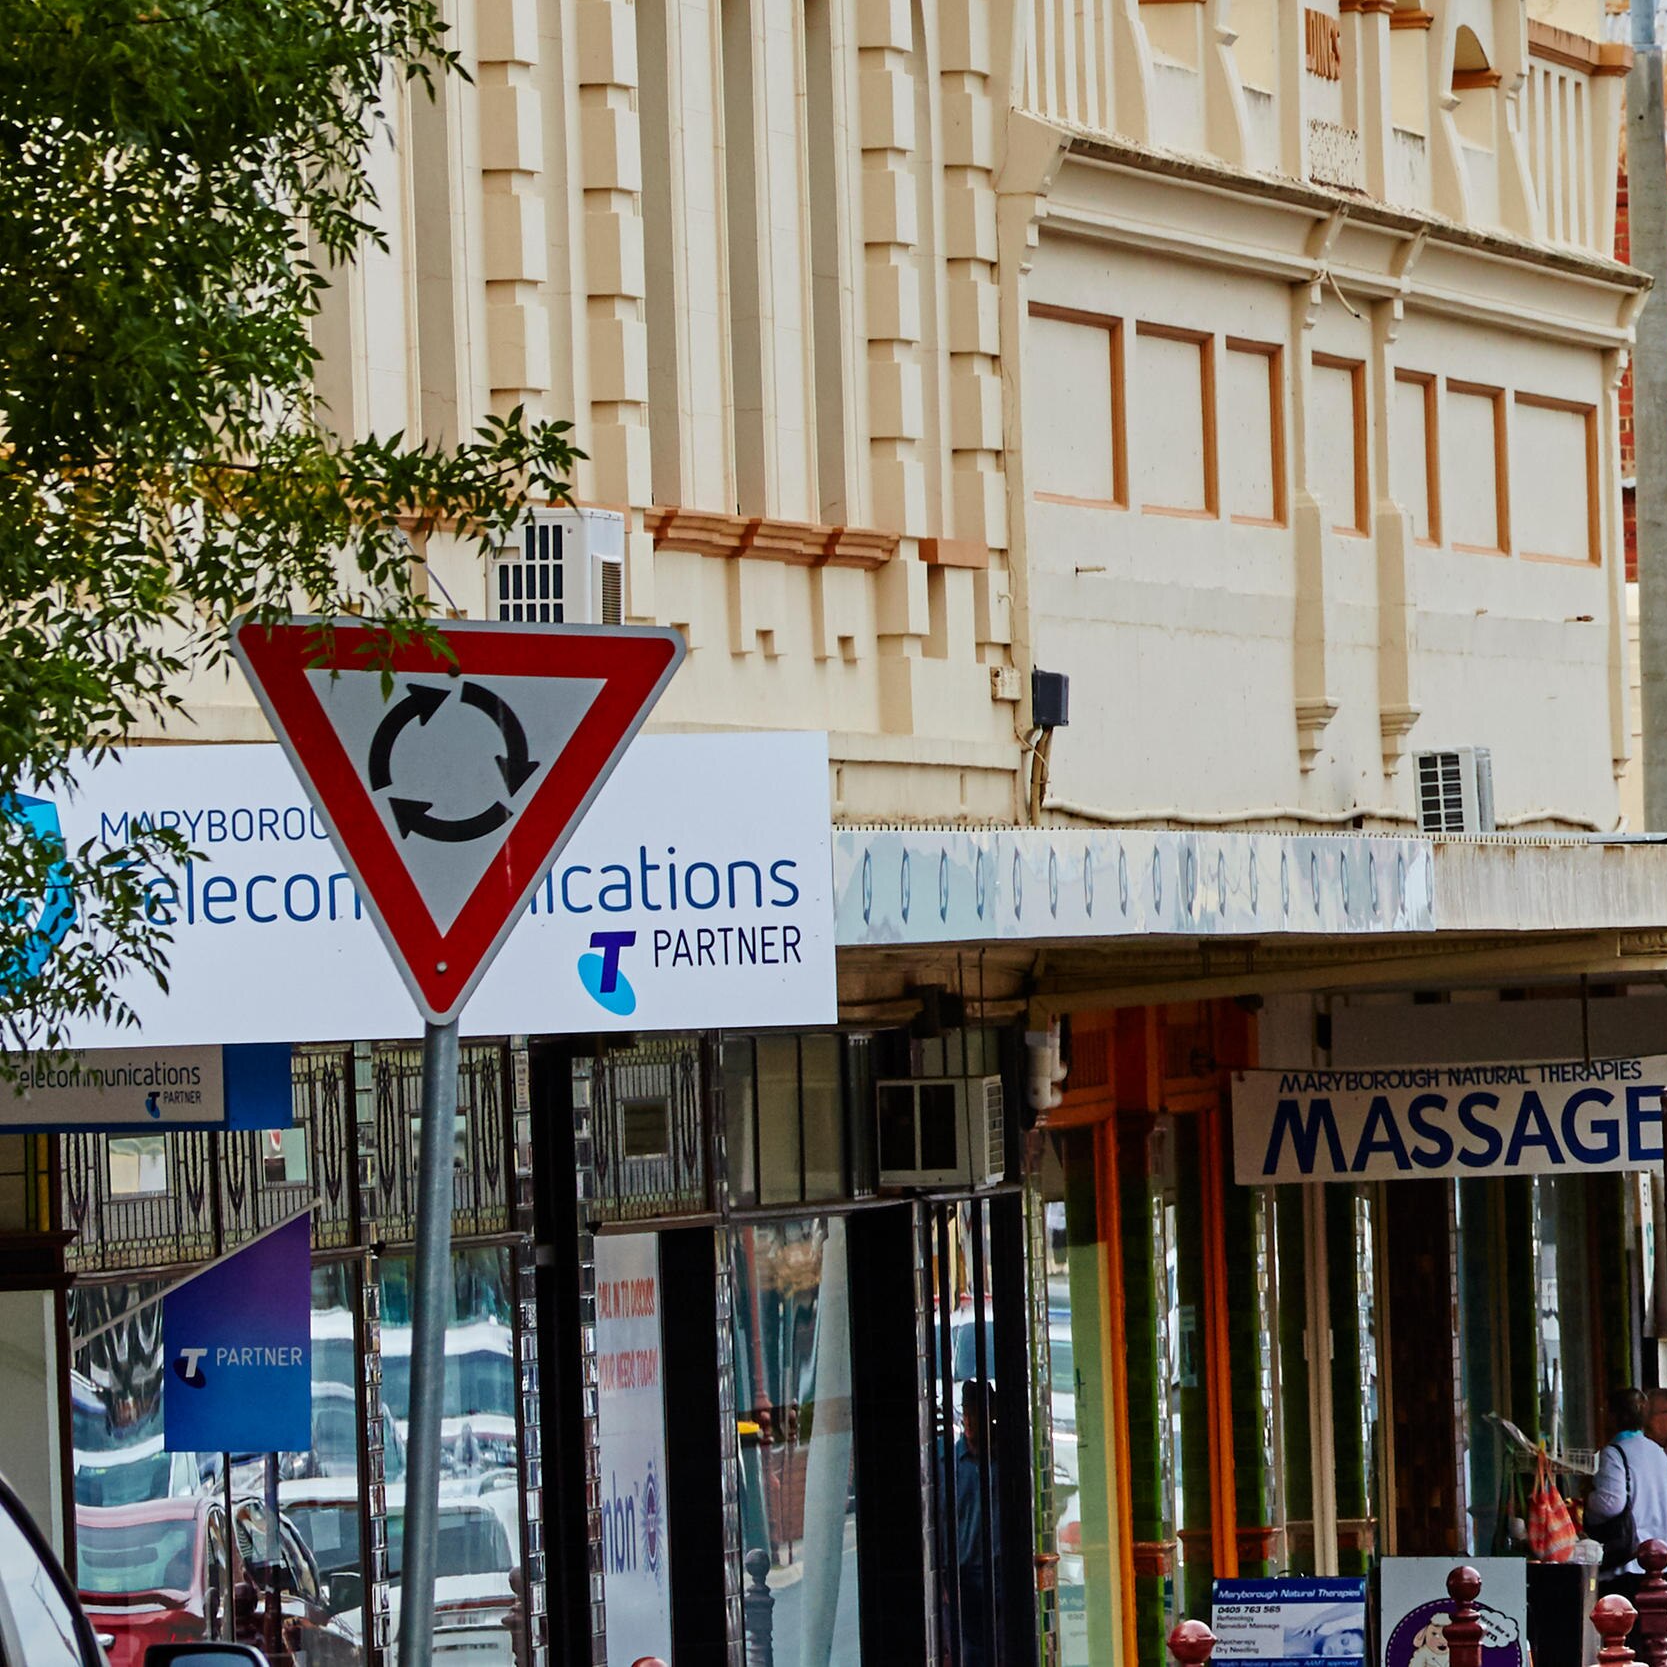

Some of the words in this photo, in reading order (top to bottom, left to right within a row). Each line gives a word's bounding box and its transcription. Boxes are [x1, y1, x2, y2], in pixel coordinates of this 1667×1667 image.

[101, 806, 331, 844] MARYBOROU
[654, 925, 801, 968] PARTNER
[1279, 1067, 1440, 1094] MARYBOROUGH
[1448, 1064, 1531, 1087] NATURAL
[1537, 1059, 1643, 1085] THERAPIES
[163, 1090, 202, 1104] PARTNER
[1262, 1085, 1666, 1176] MASSAGE
[216, 1347, 302, 1366] PARTNER
[1218, 1589, 1278, 1601] Maryborough
[1280, 1588, 1316, 1599] Natural
[1318, 1588, 1361, 1599] Therapies
